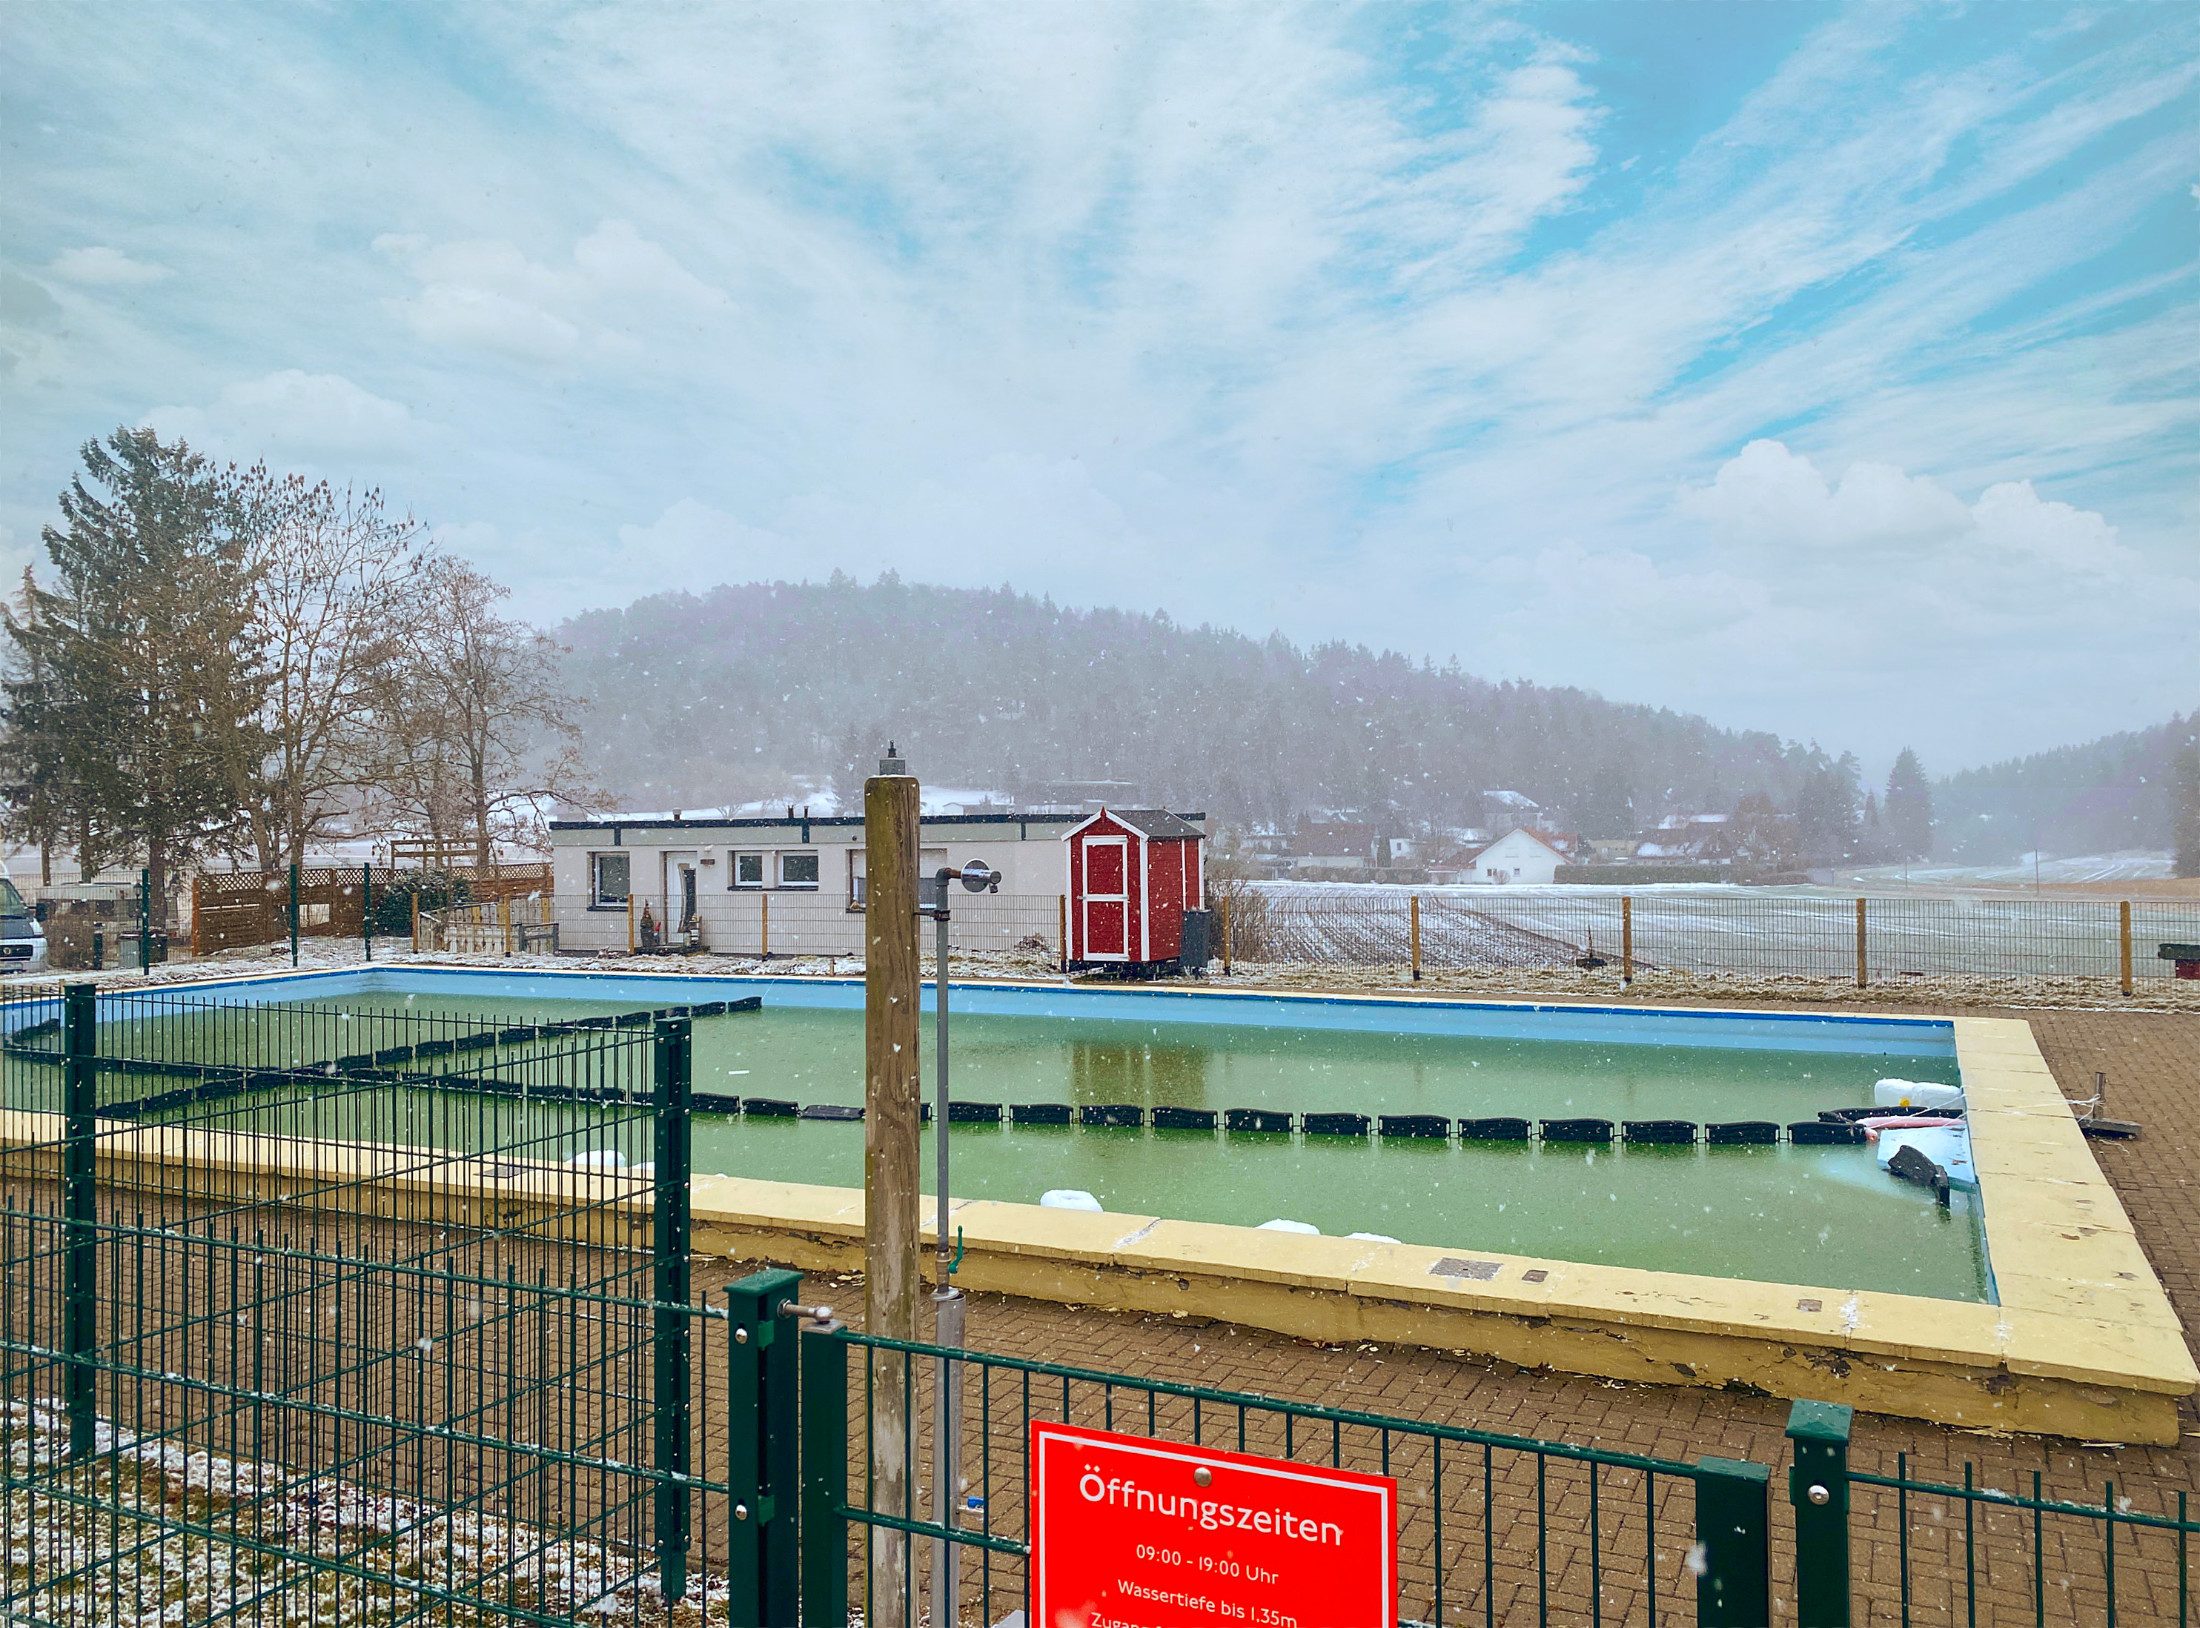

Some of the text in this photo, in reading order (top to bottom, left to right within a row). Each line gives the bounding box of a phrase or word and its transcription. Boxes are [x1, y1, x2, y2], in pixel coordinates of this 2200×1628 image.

[1079, 1463, 1344, 1546] Öffnungszeiten
[1136, 1544, 1182, 1566] 09:00
[1198, 1556, 1240, 1578] 19:00
[1246, 1565, 1279, 1585] Uhr
[1117, 1579, 1298, 1628] Wassertiefe bis 1.35m
